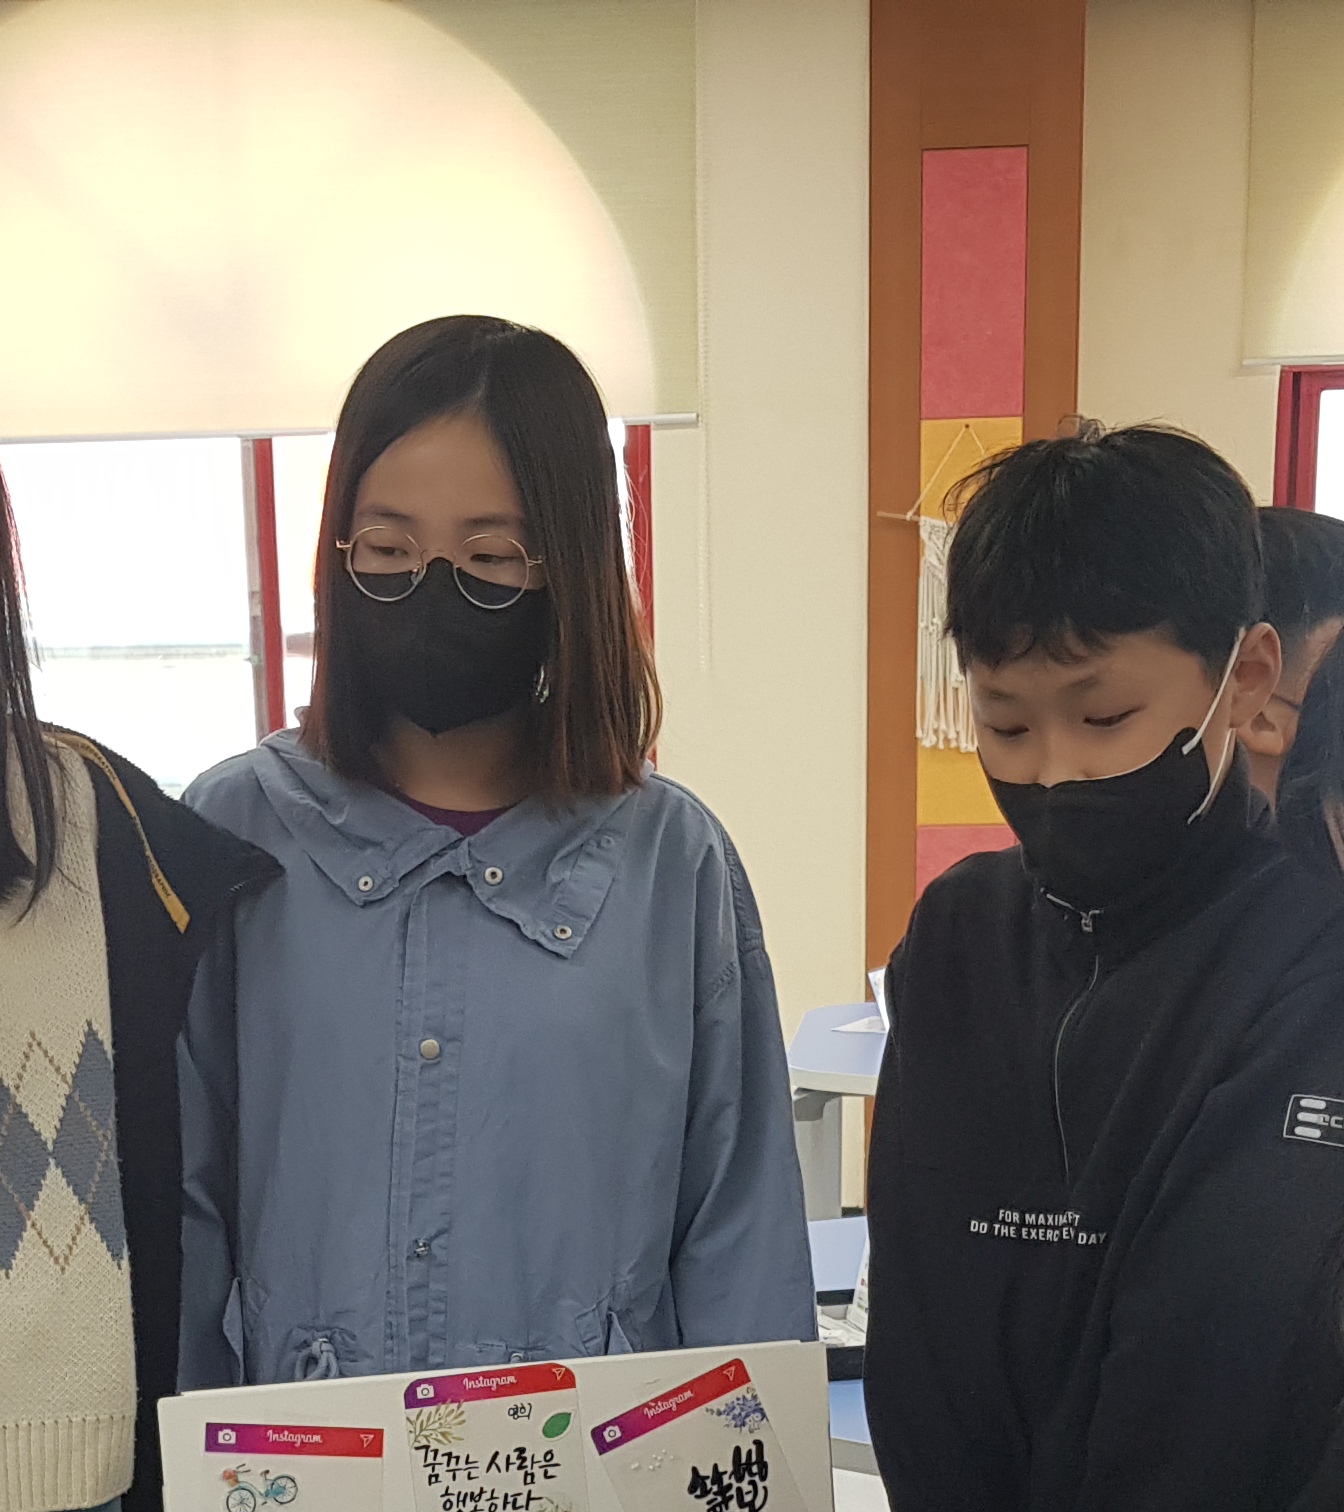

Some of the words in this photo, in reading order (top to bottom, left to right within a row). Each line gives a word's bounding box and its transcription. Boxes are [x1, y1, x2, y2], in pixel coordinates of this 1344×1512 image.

[999, 1210, 1020, 1223] FOR
[970, 1220, 988, 1234] DO
[993, 1224, 1017, 1238] THE
[1078, 1232, 1106, 1245] DAY
[463, 1375, 517, 1392] Instagram
[644, 1389, 694, 1419] Instagram
[267, 1430, 323, 1447] Instagram
[414, 1445, 479, 1487] 꿈꾸는
[486, 1446, 561, 1486] 사람은
